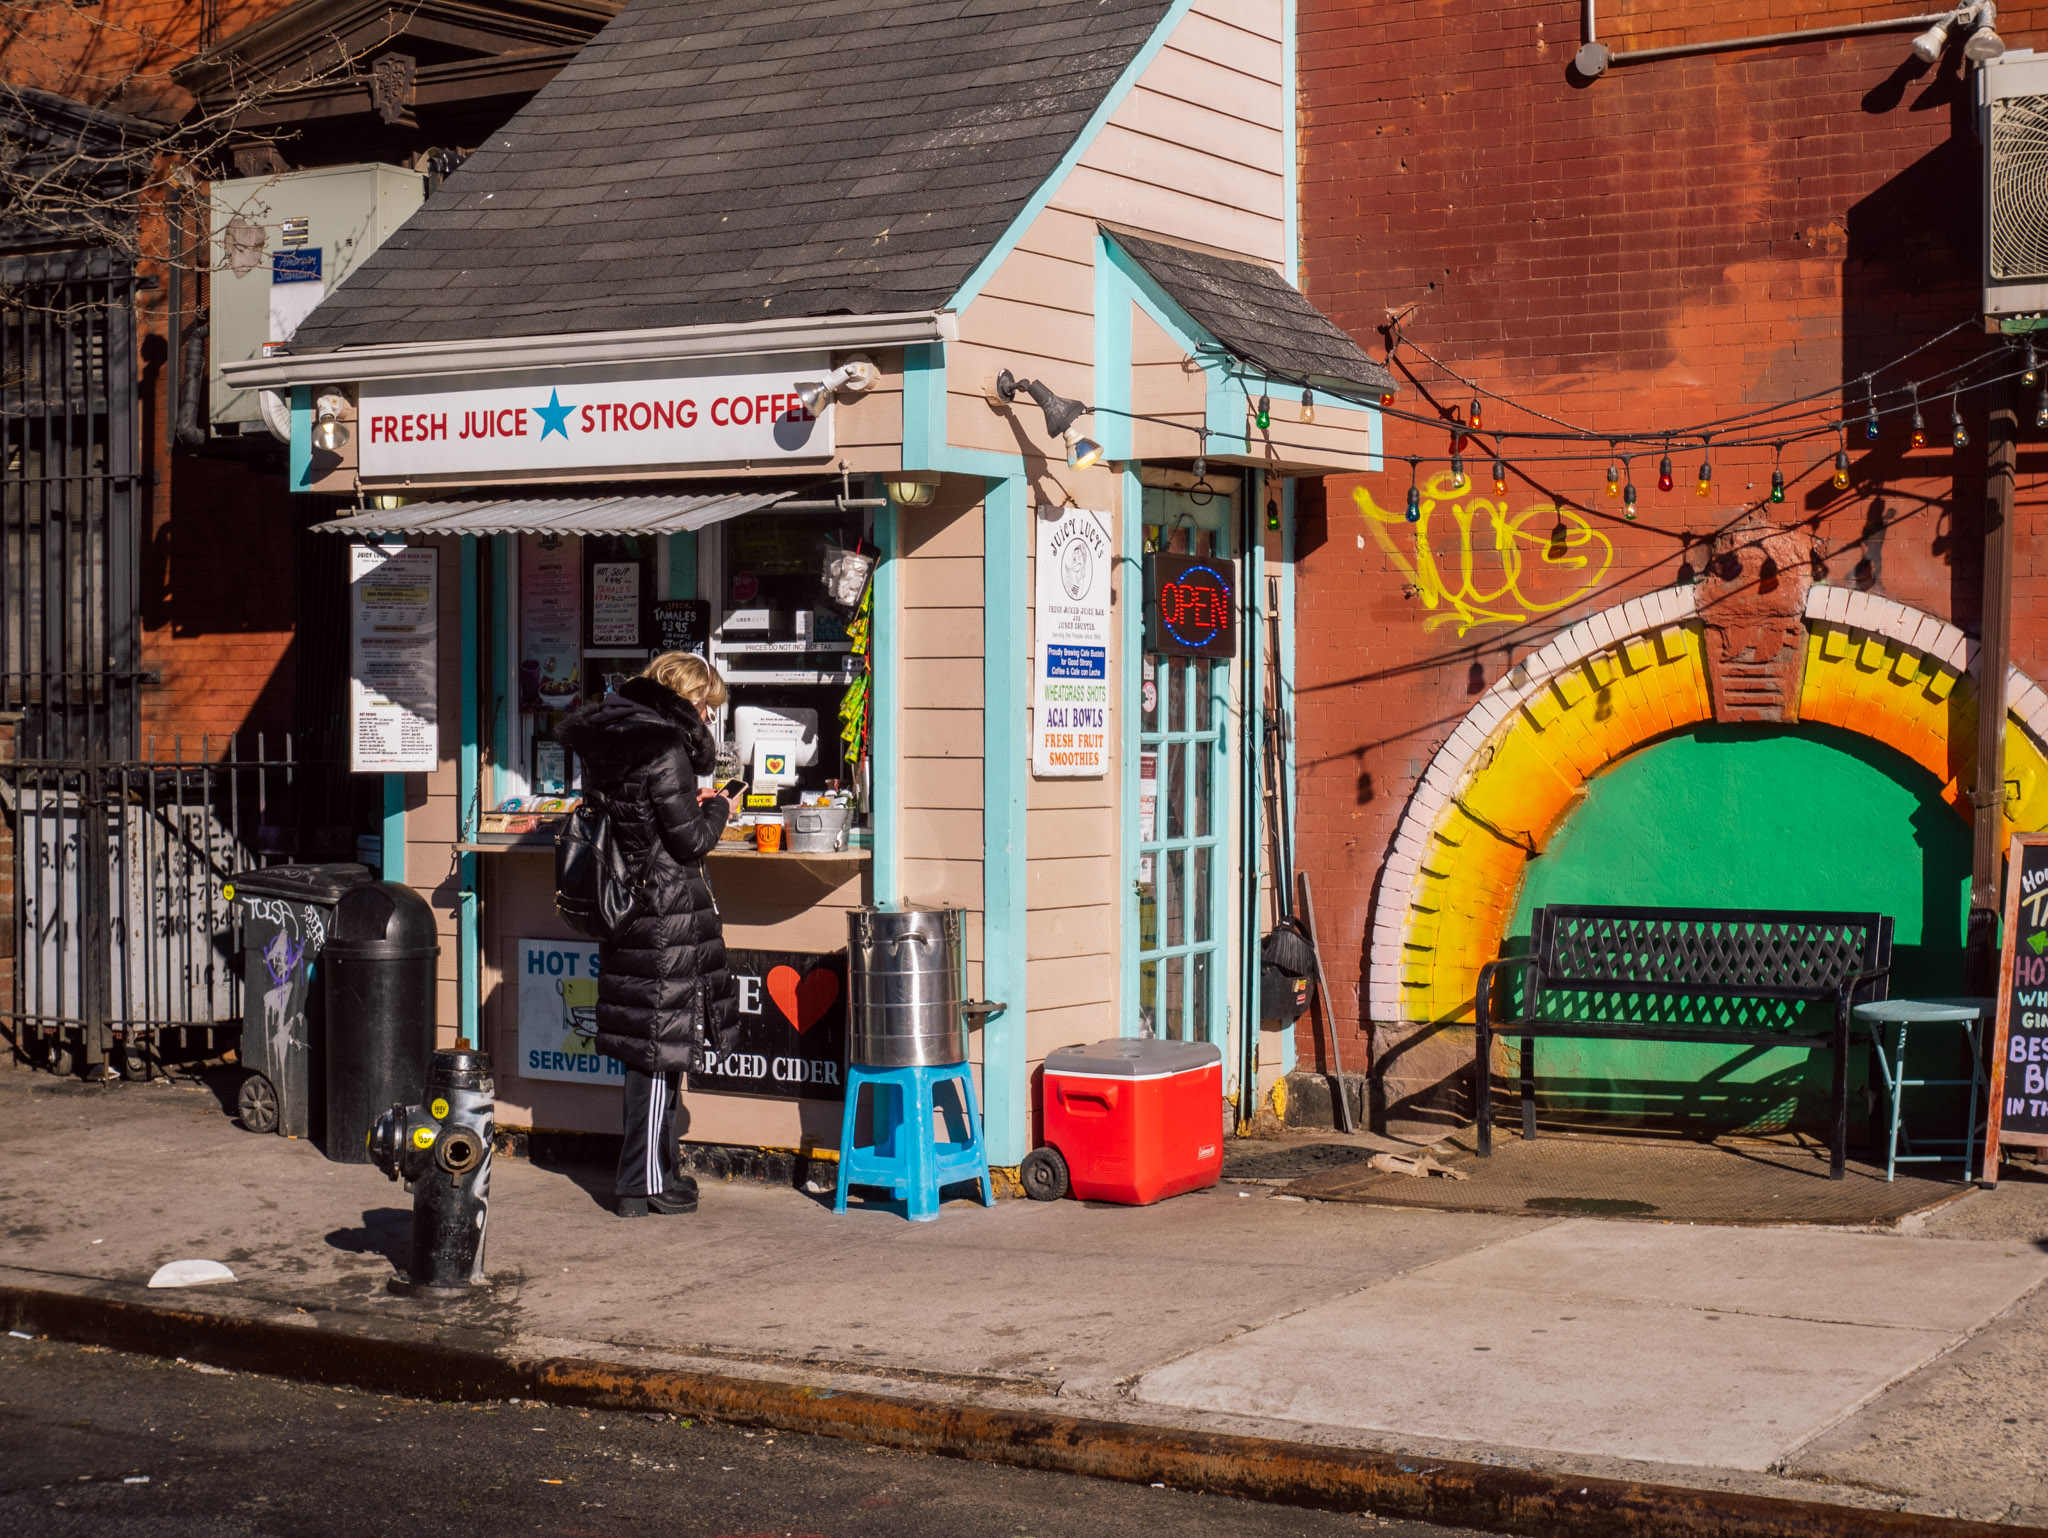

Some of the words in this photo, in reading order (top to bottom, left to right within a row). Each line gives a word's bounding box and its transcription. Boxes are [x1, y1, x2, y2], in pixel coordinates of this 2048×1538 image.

[279, 254, 317, 267] American
[277, 267, 318, 281] Standard
[371, 412, 447, 443] FRESH
[458, 408, 527, 439] JUICE
[580, 398, 697, 434] STRONG
[596, 568, 608, 576] HOT
[612, 567, 630, 576] SOUP
[1048, 605, 1062, 613] FRESH
[1063, 606, 1079, 614] MIXED
[1081, 608, 1094, 616] JUICE
[1095, 608, 1104, 616] BAR
[1162, 584, 1228, 629] OPEN
[653, 607, 697, 622] TAMALES
[1074, 622, 1095, 630] COUNTER
[1049, 647, 1063, 657] Proudly
[1064, 648, 1079, 658] Brewing
[1080, 649, 1089, 657] Cafe
[1090, 649, 1104, 657] Bustelo
[1068, 658, 1079, 666] Good
[1080, 658, 1092, 668] Strong
[1052, 666, 1065, 675] Coffee
[1071, 667, 1080, 675] Cafe
[1089, 668, 1101, 676] Leche
[1044, 684, 1085, 702] WHEATGRASS
[1087, 685, 1106, 702] SHOTS
[1047, 708, 1068, 728] ACAI
[1073, 708, 1103, 728] BOWLS
[1045, 733, 1073, 748] FRESH
[1078, 734, 1104, 748] FRUIT
[1050, 752, 1099, 766] SMOOTHIES
[528, 950, 580, 977] HOT
[2014, 956, 2048, 987] HO
[529, 1050, 600, 1073] SERVED
[772, 1057, 840, 1086] CIDER
[434, 1104, 446, 1114] iggy
[2006, 1097, 2025, 1116] IN
